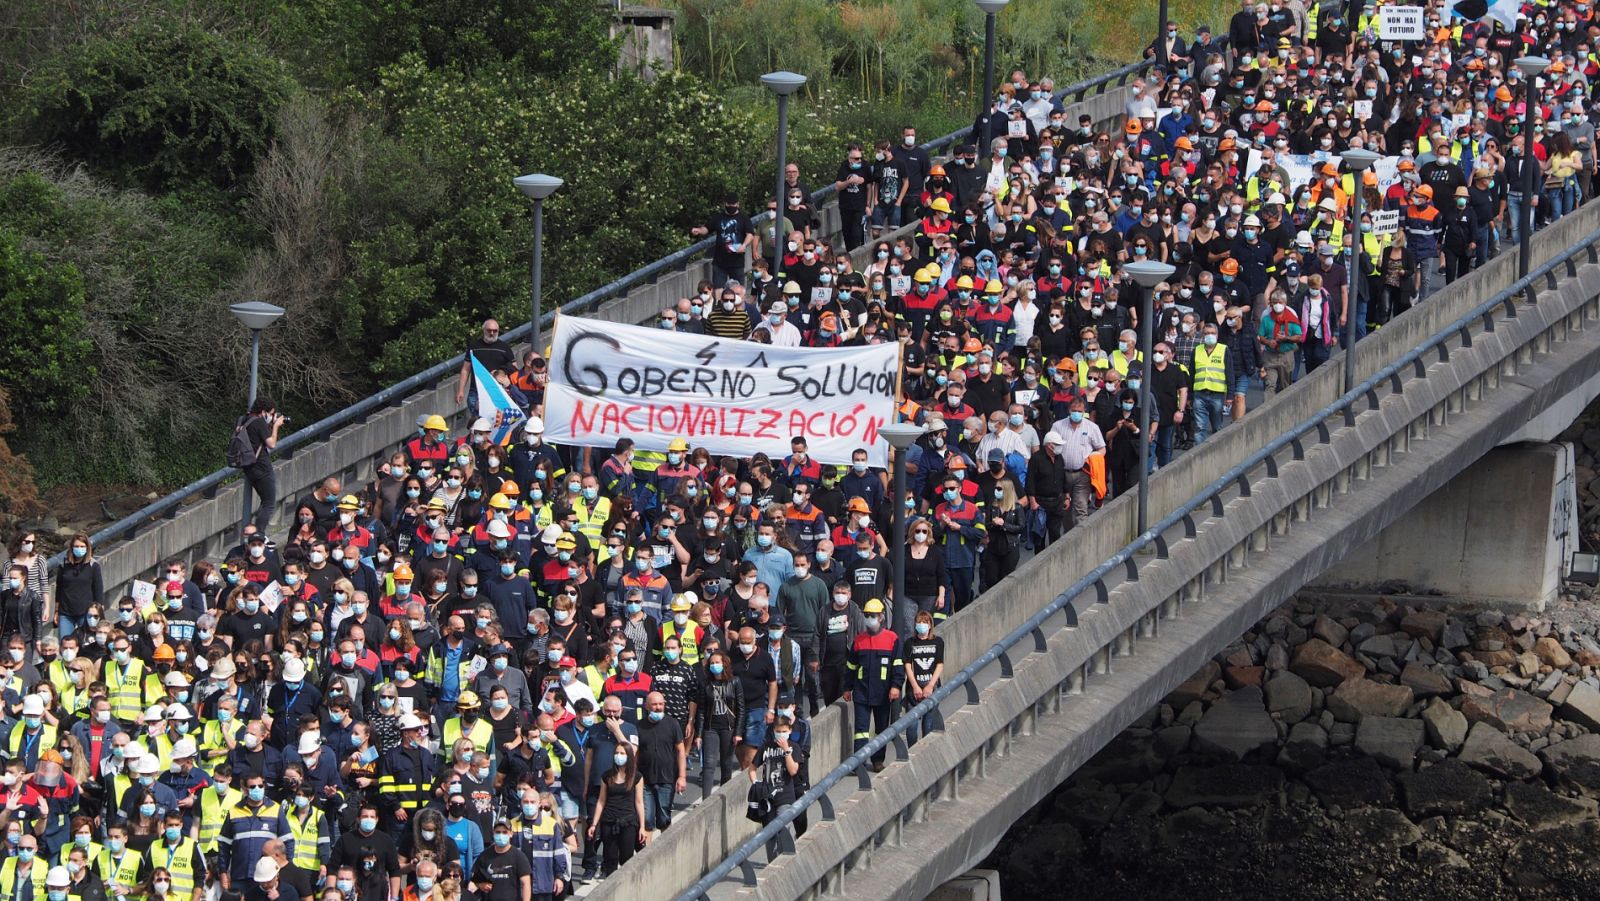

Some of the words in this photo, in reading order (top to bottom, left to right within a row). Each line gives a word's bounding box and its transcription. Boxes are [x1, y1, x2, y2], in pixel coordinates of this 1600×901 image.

[1389, 26, 1415, 34] FUTURO
[564, 331, 756, 400] GOBERNO
[769, 354, 898, 400] SOLUCIÓN
[570, 400, 885, 446] NACIONALIZACIÓN
[912, 646, 937, 655] EMPORIO
[118, 873, 134, 883] NON
